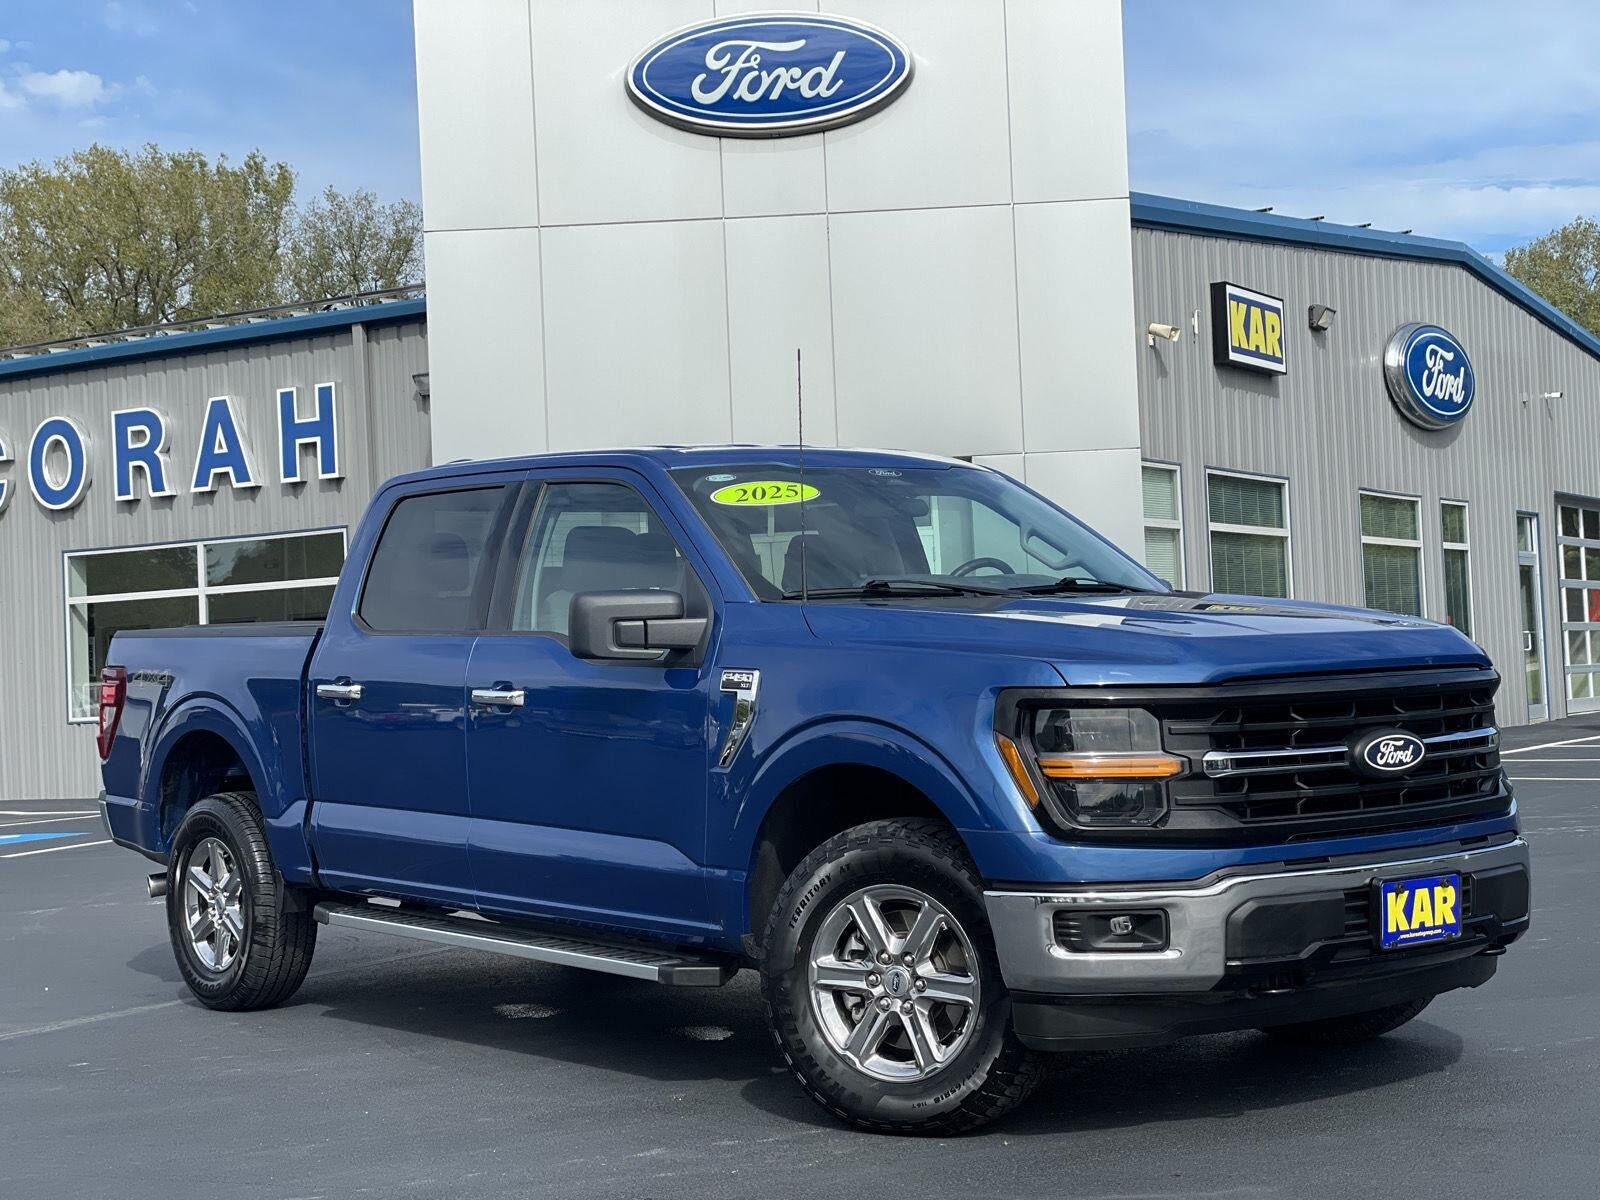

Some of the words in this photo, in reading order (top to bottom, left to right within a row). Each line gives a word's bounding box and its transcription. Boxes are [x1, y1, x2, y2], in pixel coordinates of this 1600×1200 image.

[691, 39, 846, 104] Ford
[1229, 299, 1283, 358] KAR
[1422, 343, 1465, 404] Ford
[0, 381, 343, 511] ORAH
[735, 484, 799, 503] 2025
[1377, 739, 1414, 765] Ford
[788, 872, 832, 930] TERRITORY
[1386, 885, 1456, 933] KAR
